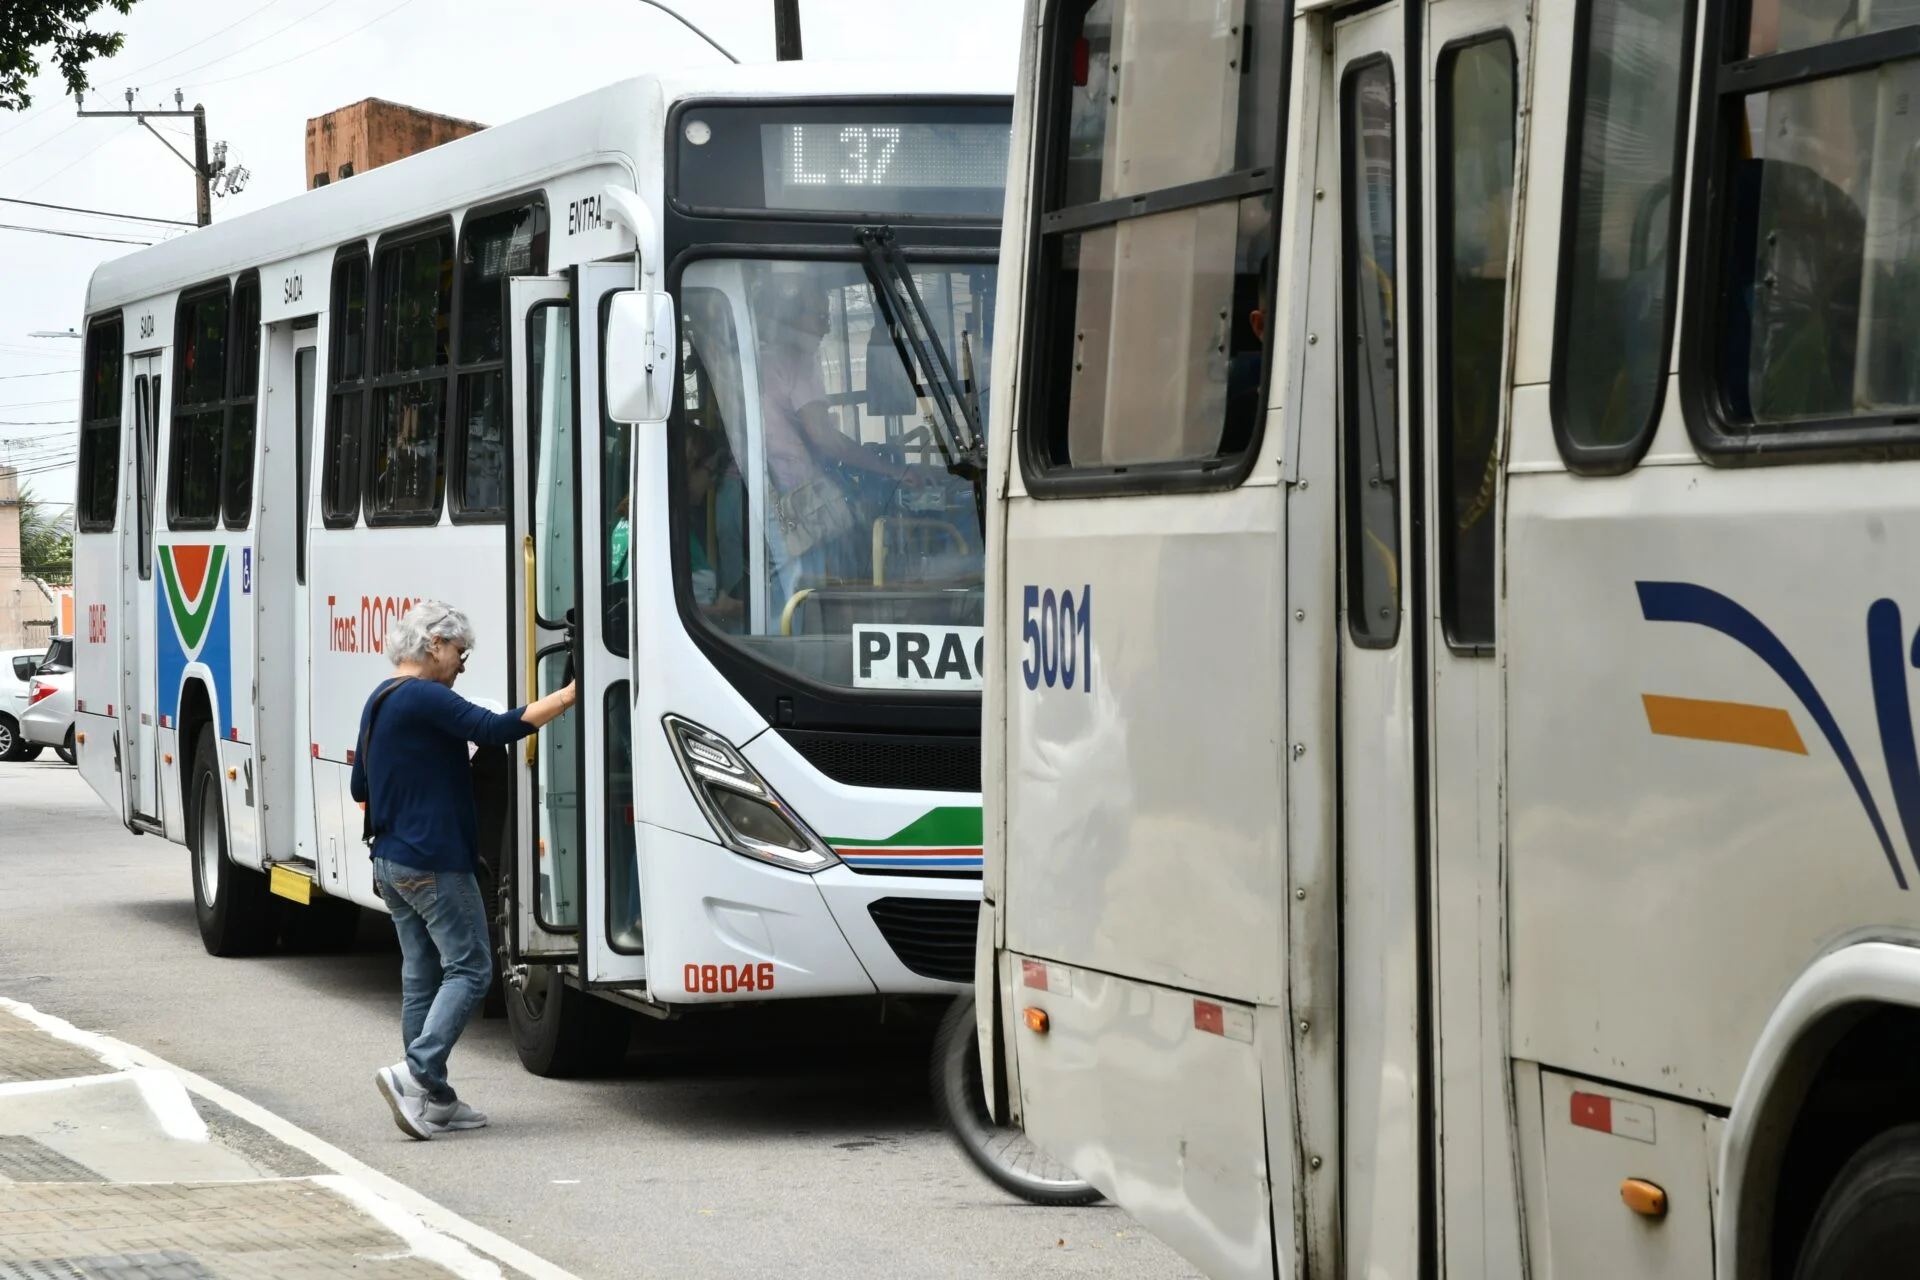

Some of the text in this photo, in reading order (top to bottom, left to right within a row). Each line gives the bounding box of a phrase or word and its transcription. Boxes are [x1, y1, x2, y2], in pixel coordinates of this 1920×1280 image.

[793, 126, 900, 184] L 37
[568, 193, 604, 236] ENTRA
[284, 269, 303, 305] SAÍDA
[859, 631, 984, 680] PRA
[1022, 584, 1091, 693] 5001
[684, 962, 775, 993] 08046
